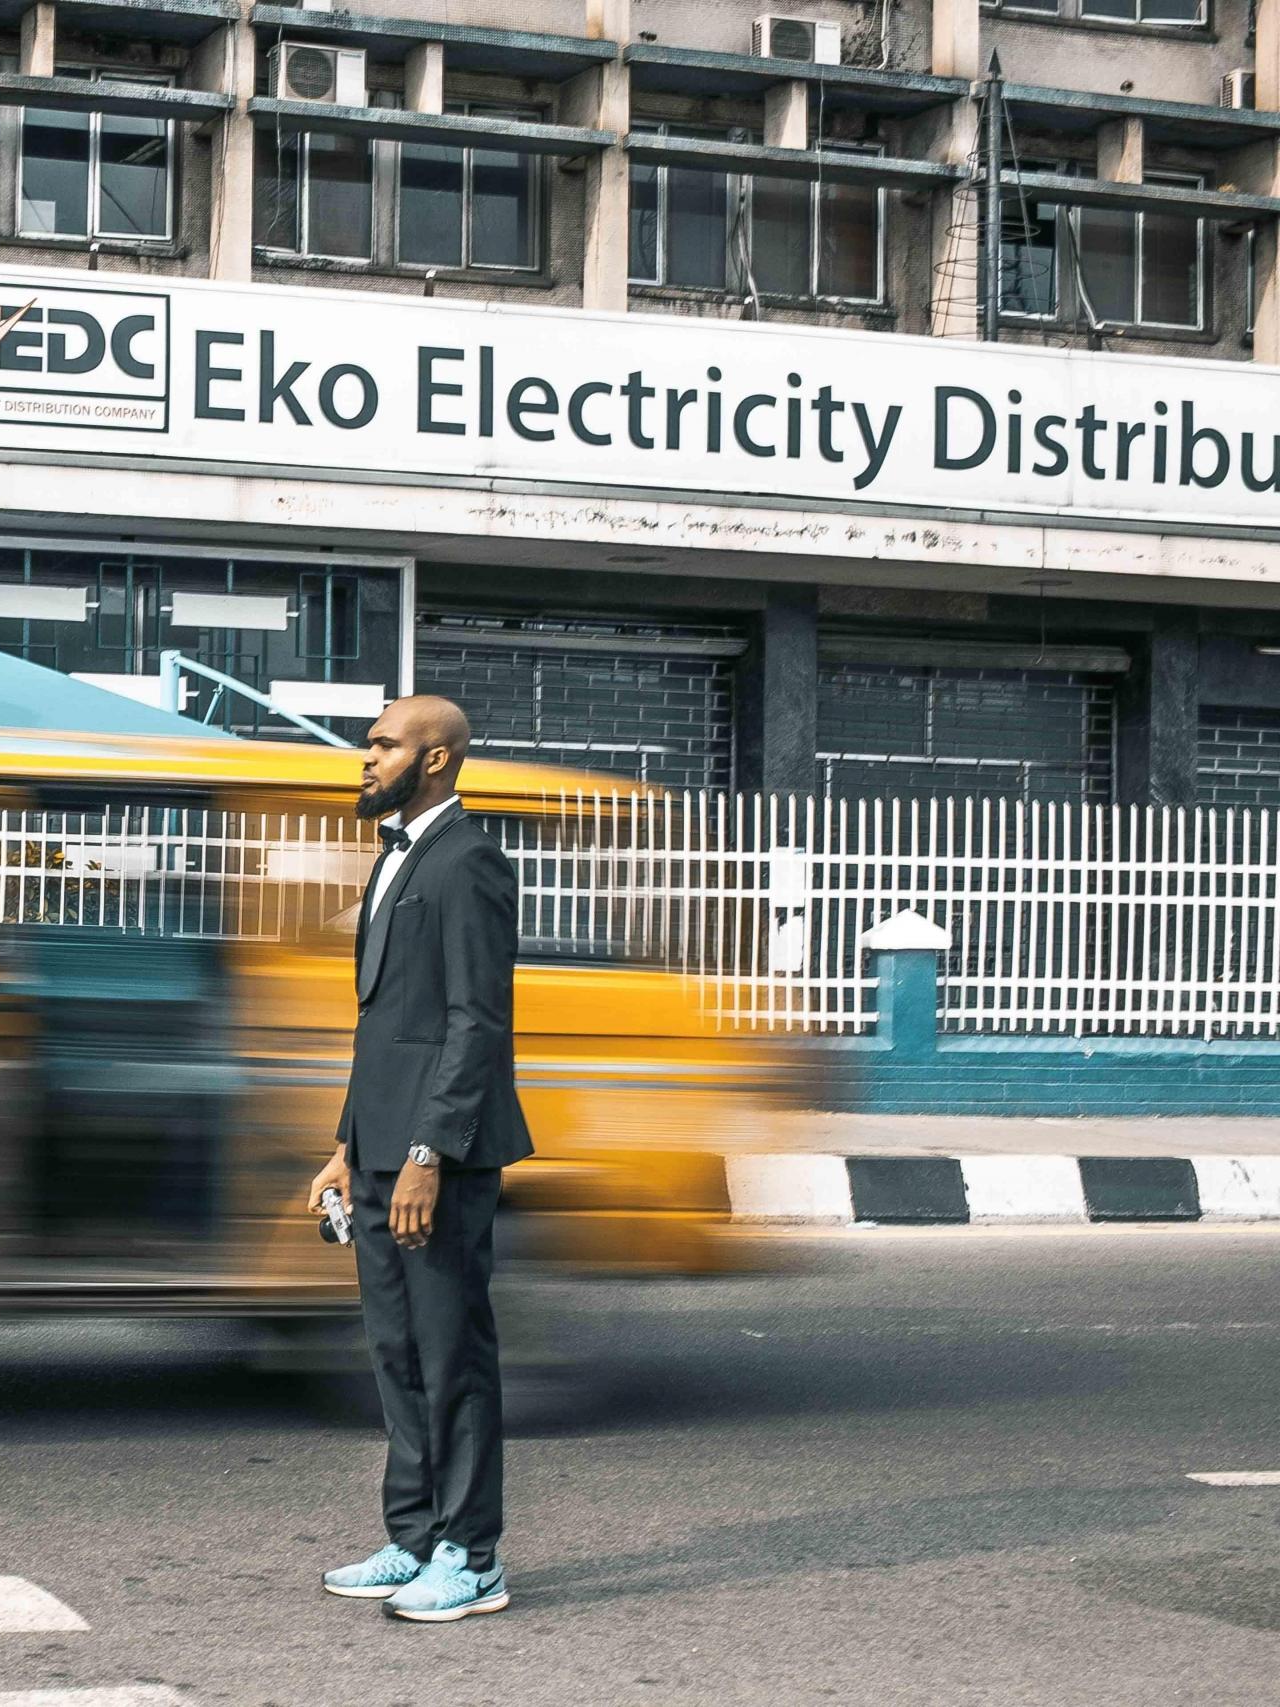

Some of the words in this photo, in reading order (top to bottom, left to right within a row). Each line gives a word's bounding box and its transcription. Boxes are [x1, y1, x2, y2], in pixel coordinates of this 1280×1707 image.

[4, 400, 91, 416] DISTRIBUTION
[94, 406, 156, 420] COMPANY
[195, 329, 379, 430] Eko
[417, 345, 903, 491] Electricity
[933, 386, 1280, 493] Distribu
